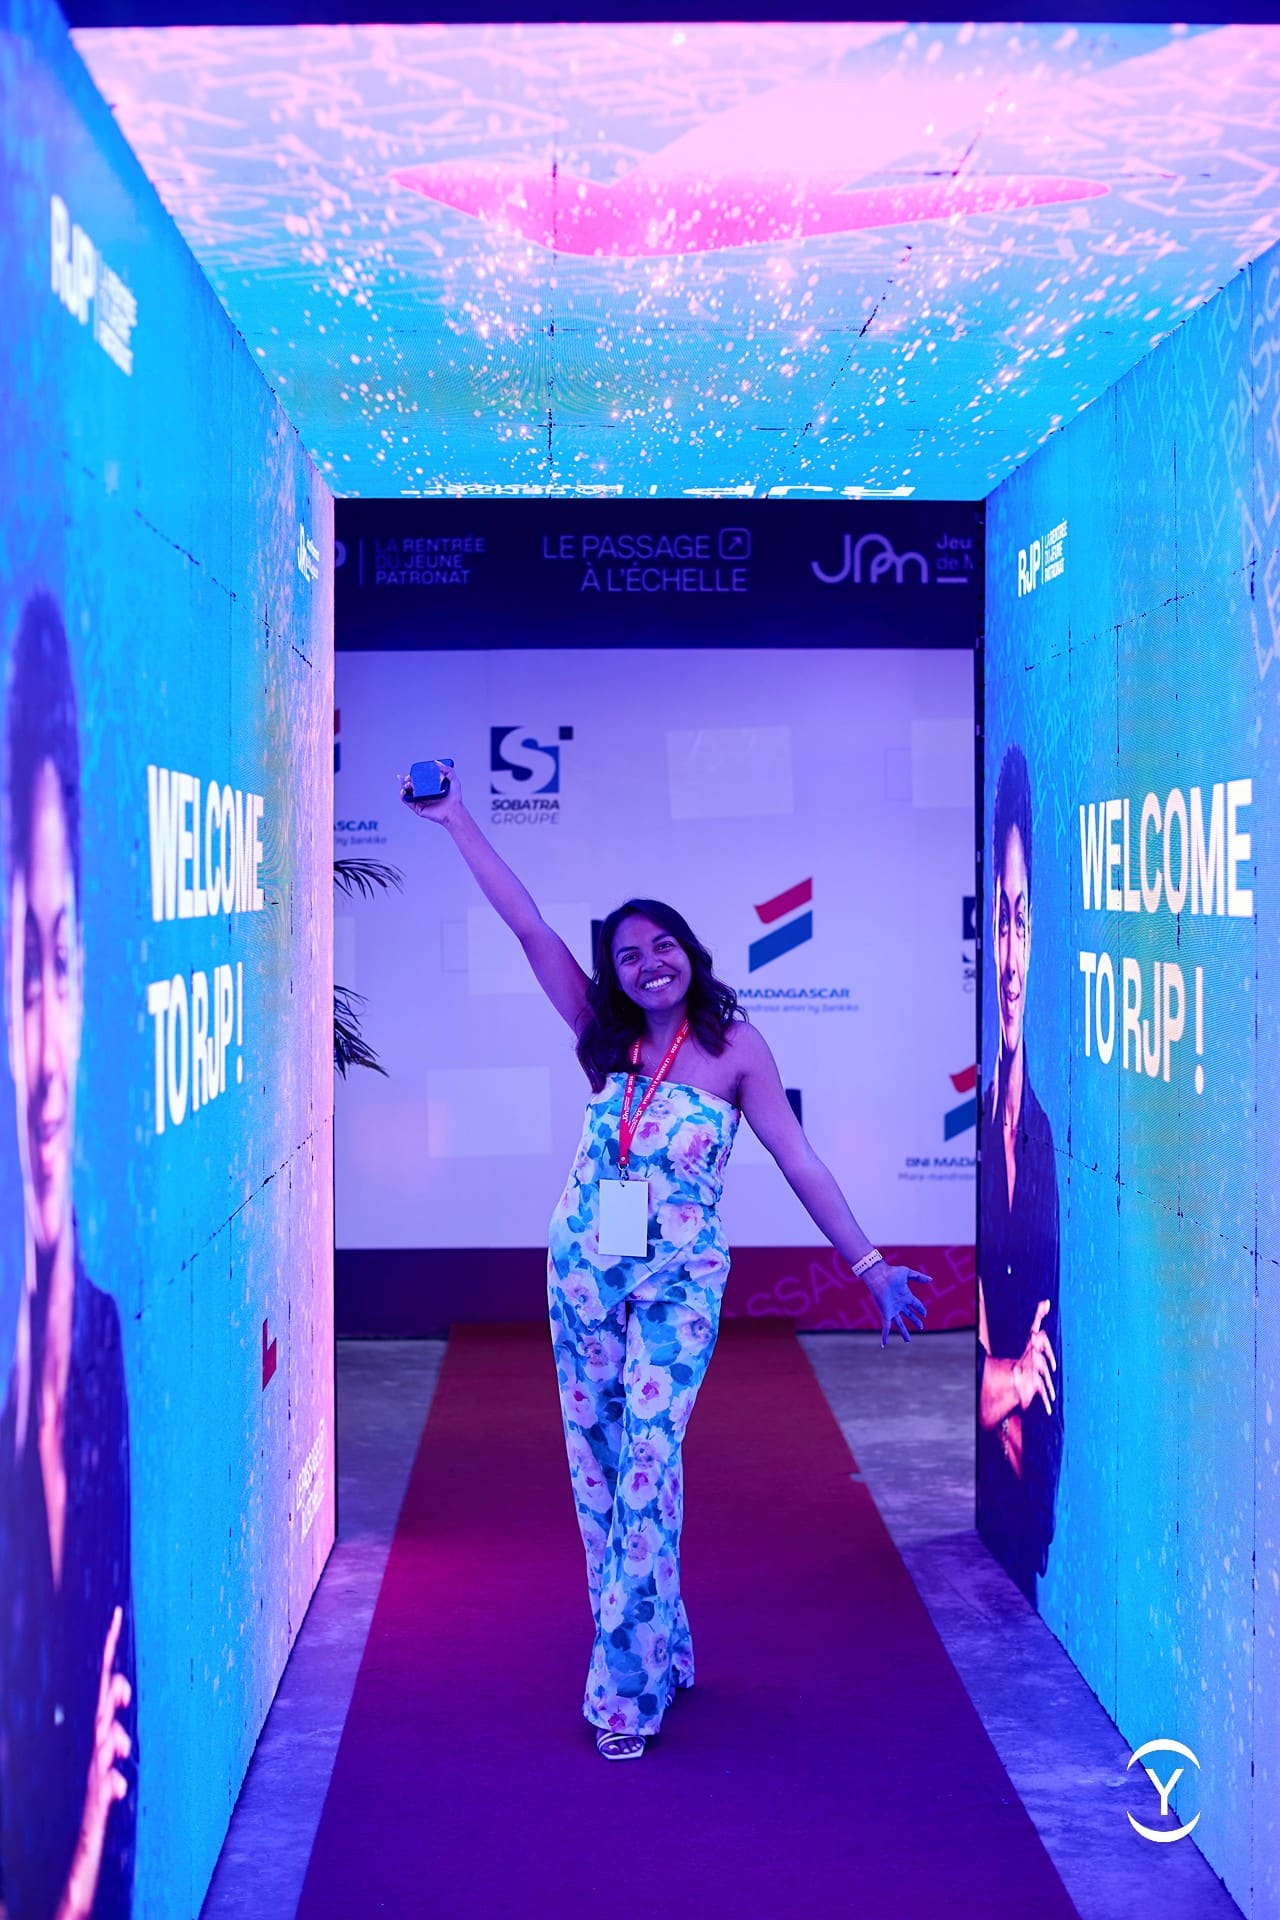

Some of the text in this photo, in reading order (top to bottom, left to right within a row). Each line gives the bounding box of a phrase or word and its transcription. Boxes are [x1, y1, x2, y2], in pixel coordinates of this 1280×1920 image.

[51, 196, 96, 323] RJP
[374, 535, 486, 553] LA RENTRÉE
[543, 534, 711, 560] LE PASSAGE
[374, 553, 463, 570] DU JEUNE
[1018, 540, 1041, 597] RJP
[375, 569, 471, 586] PATRONAT
[580, 561, 749, 592] À L'ÉCHELLE
[491, 799, 560, 812] SOBATRA
[491, 812, 560, 825] GROUPE
[147, 765, 264, 922] WELCOME
[1079, 778, 1253, 917] WELCOME
[738, 987, 850, 1000] MADAGASCAR
[1079, 951, 1115, 1065] TO
[1122, 957, 1186, 1082] RJP
[148, 974, 189, 1134] TO
[192, 964, 234, 1112] RJP
